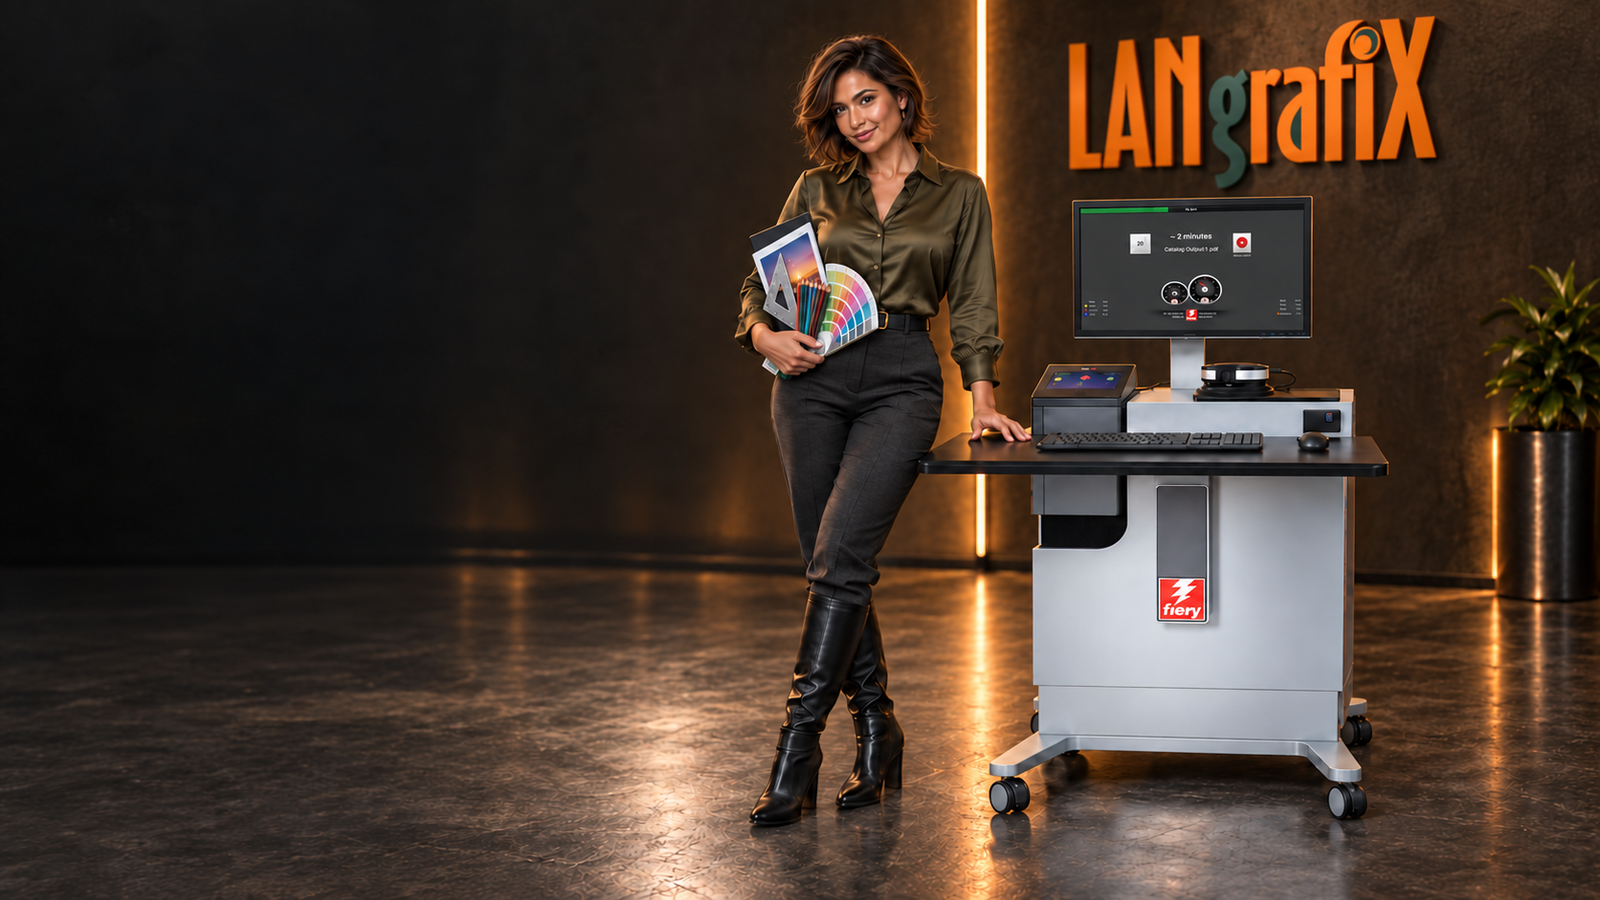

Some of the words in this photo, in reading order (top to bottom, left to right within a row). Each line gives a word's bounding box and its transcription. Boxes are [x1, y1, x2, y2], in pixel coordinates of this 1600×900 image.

[1068, 16, 1436, 188] LANgrafiX
[1183, 232, 1212, 240] minutes
[1163, 603, 1201, 619] fiery
